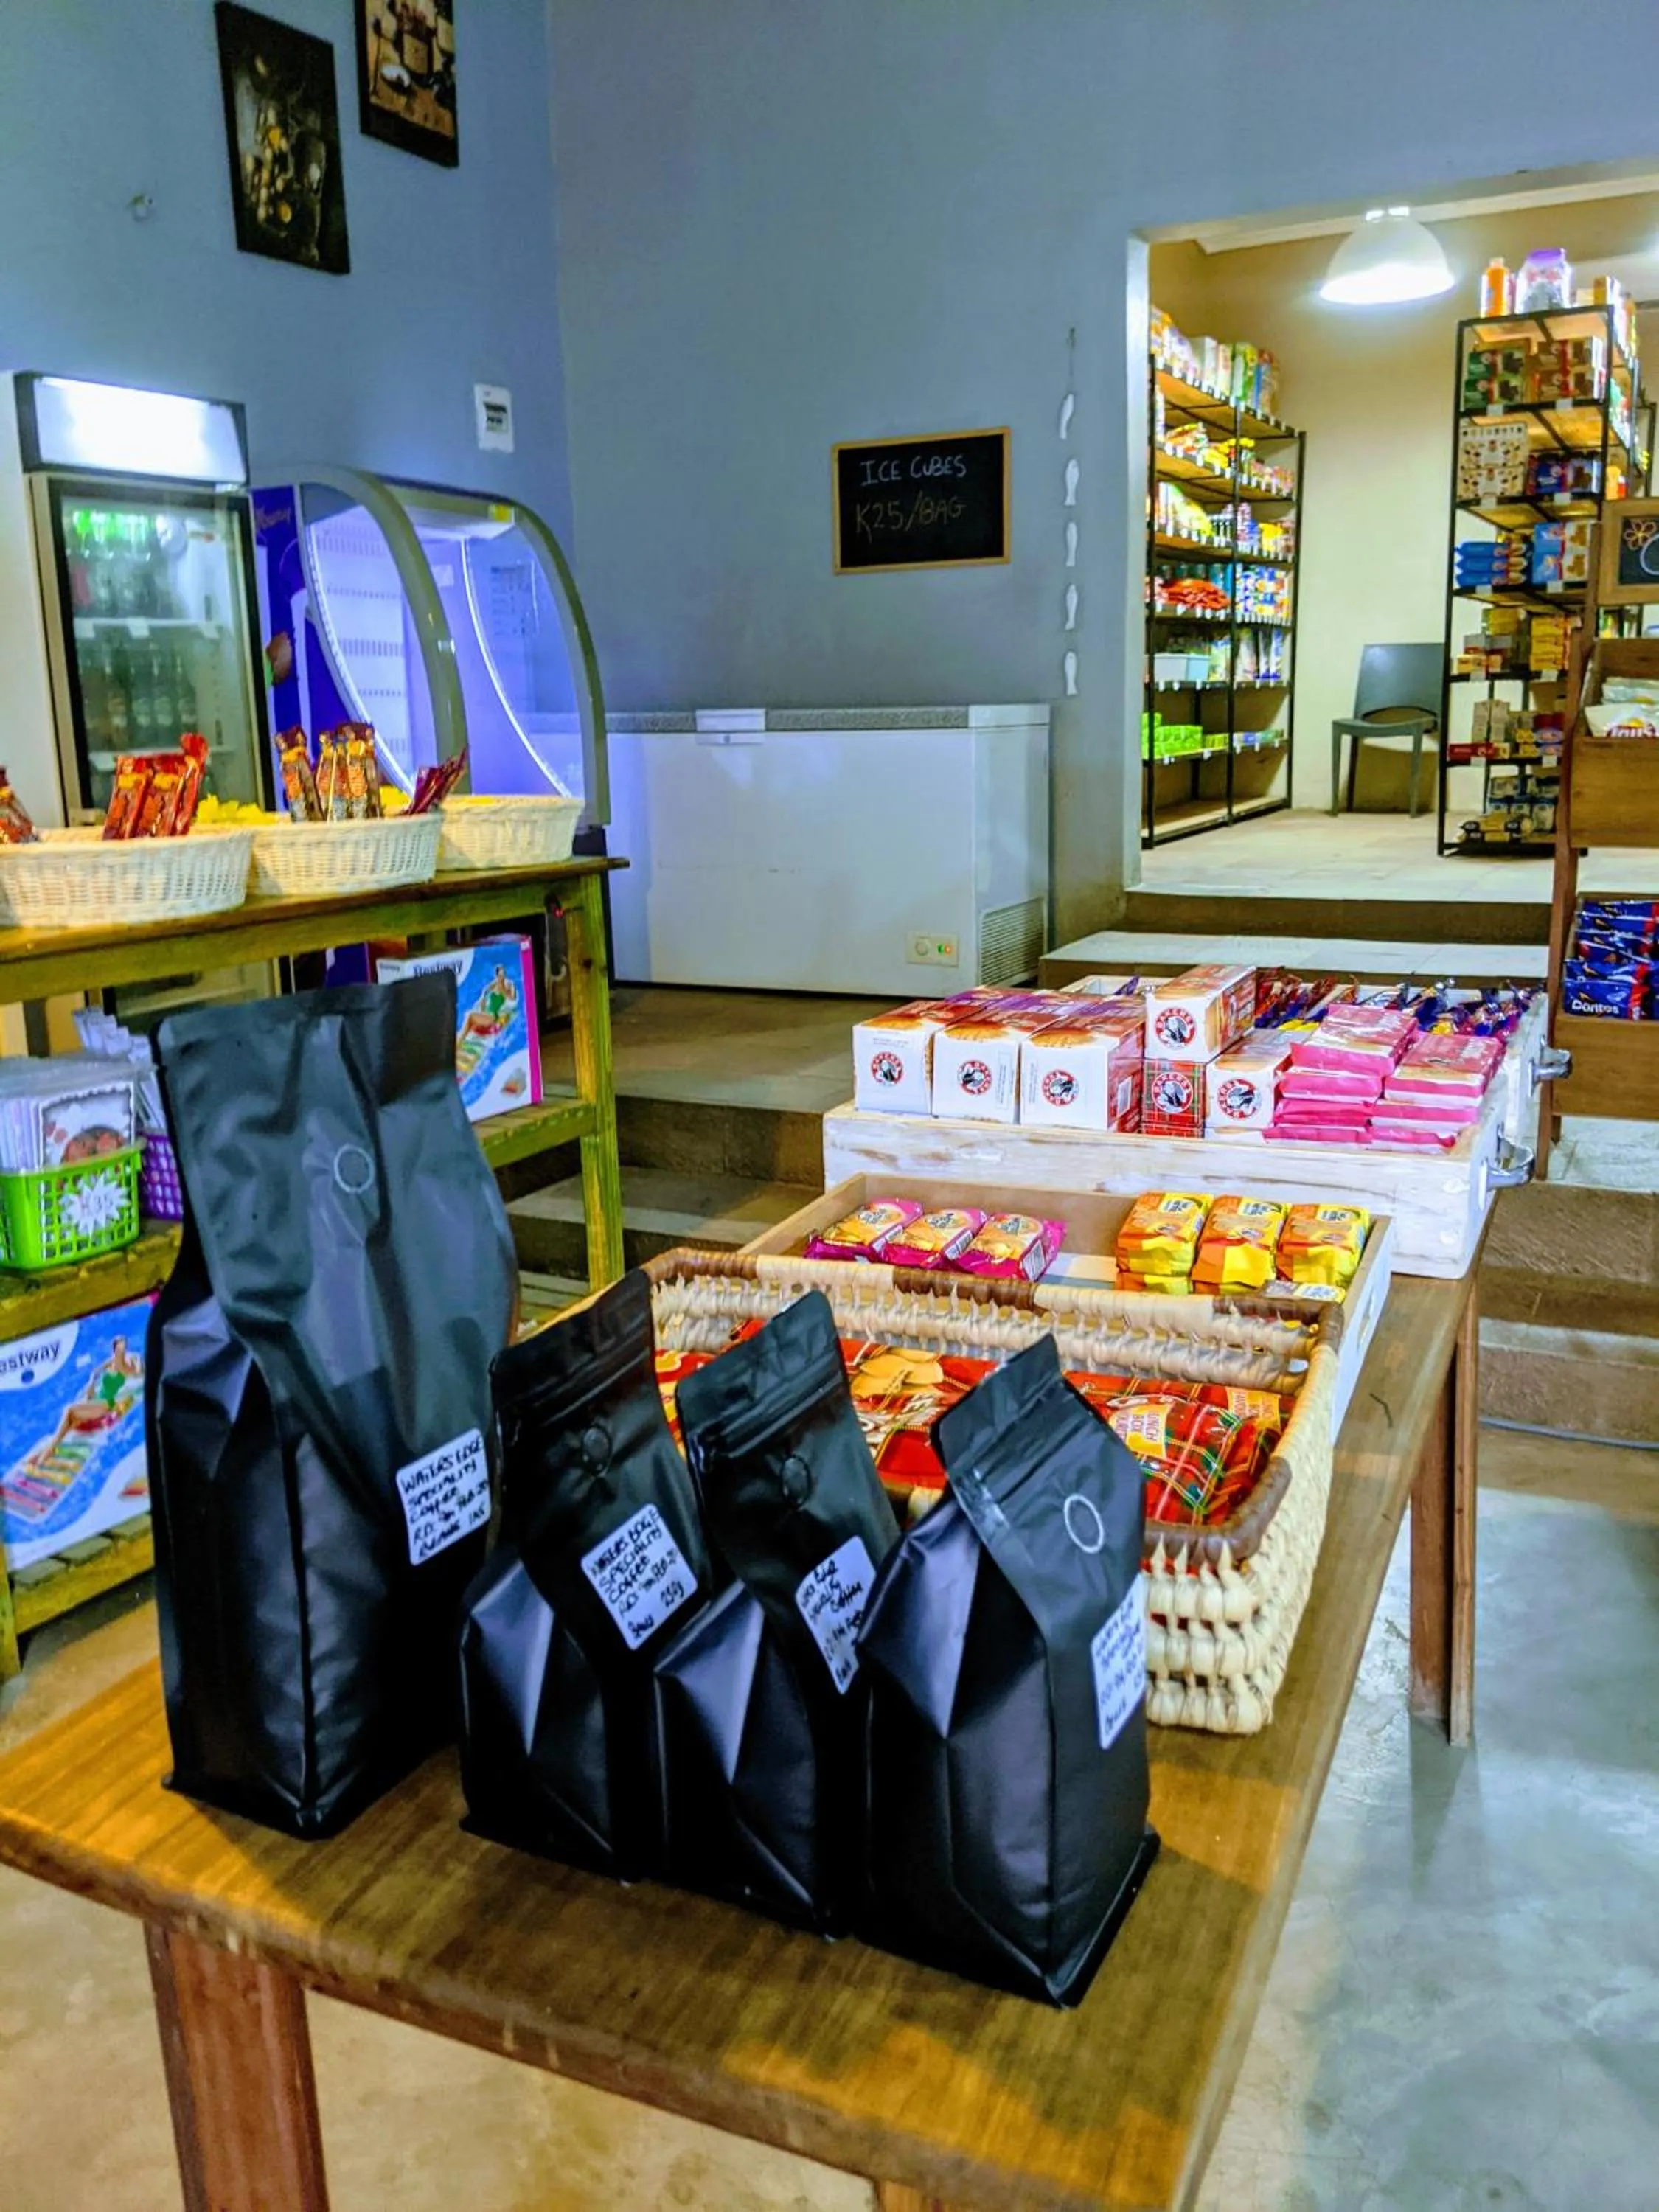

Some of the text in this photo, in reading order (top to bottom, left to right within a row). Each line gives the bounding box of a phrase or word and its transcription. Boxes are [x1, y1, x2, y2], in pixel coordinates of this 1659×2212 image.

[860, 455, 967, 486] ICE CUBES
[855, 490, 967, 543] K25/BAG
[1571, 999, 1620, 1015] Doritos
[1146, 1412, 1161, 1442] LUNCH
